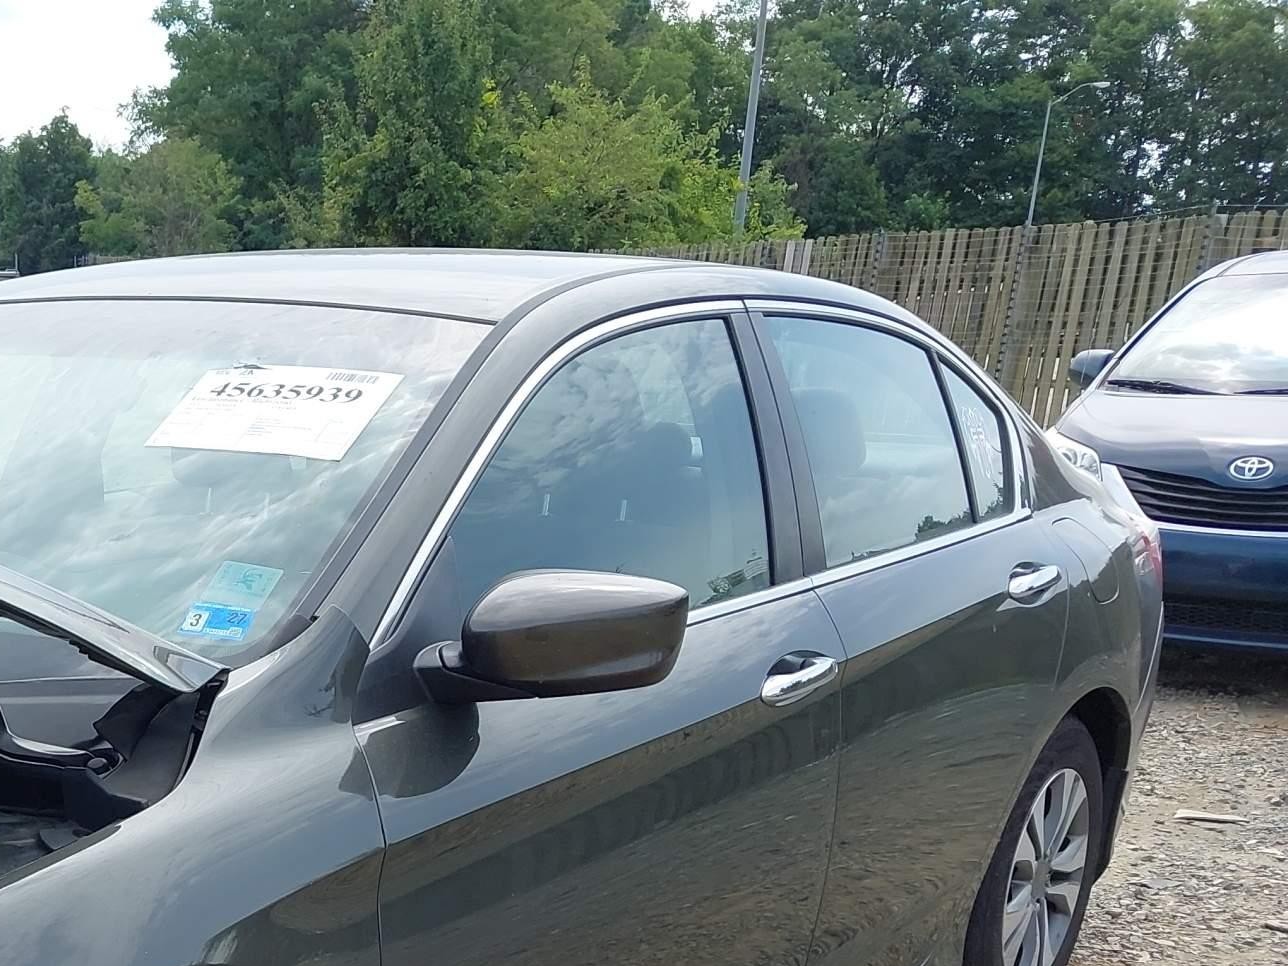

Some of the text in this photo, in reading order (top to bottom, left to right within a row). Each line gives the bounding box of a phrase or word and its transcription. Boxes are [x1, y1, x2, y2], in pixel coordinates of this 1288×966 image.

[210, 381, 364, 404] 45635939
[189, 612, 248, 628] 3 27
